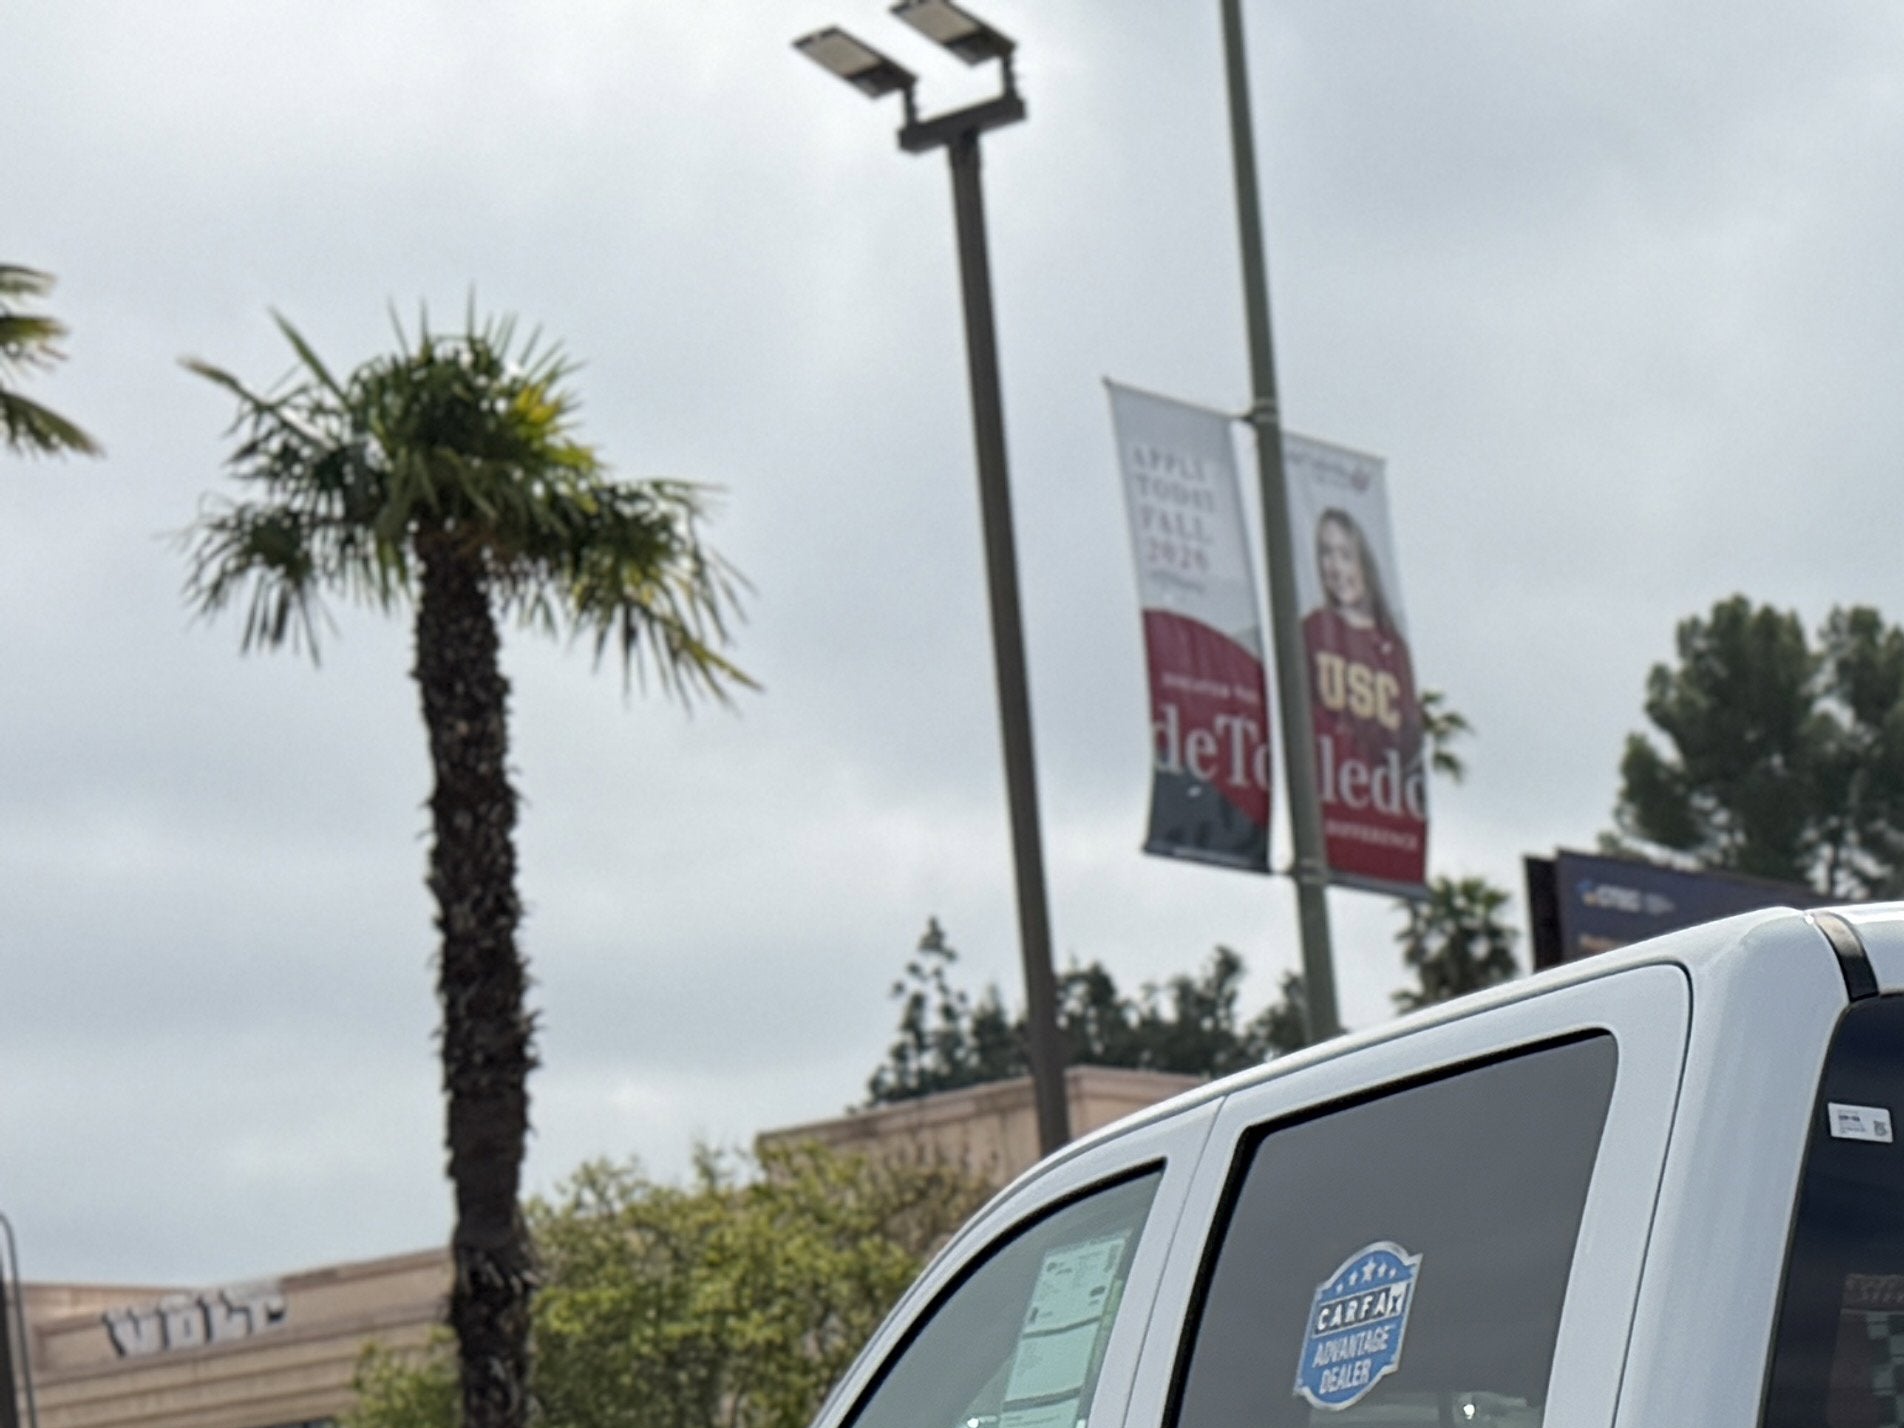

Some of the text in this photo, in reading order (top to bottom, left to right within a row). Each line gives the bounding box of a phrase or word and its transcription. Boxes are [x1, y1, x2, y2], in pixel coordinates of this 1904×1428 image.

[1316, 651, 1401, 730] USC
[1317, 1290, 1403, 1331] CARFAX
[1312, 1325, 1395, 1368] ADVANTAGE
[1319, 1358, 1371, 1395] DEALER
